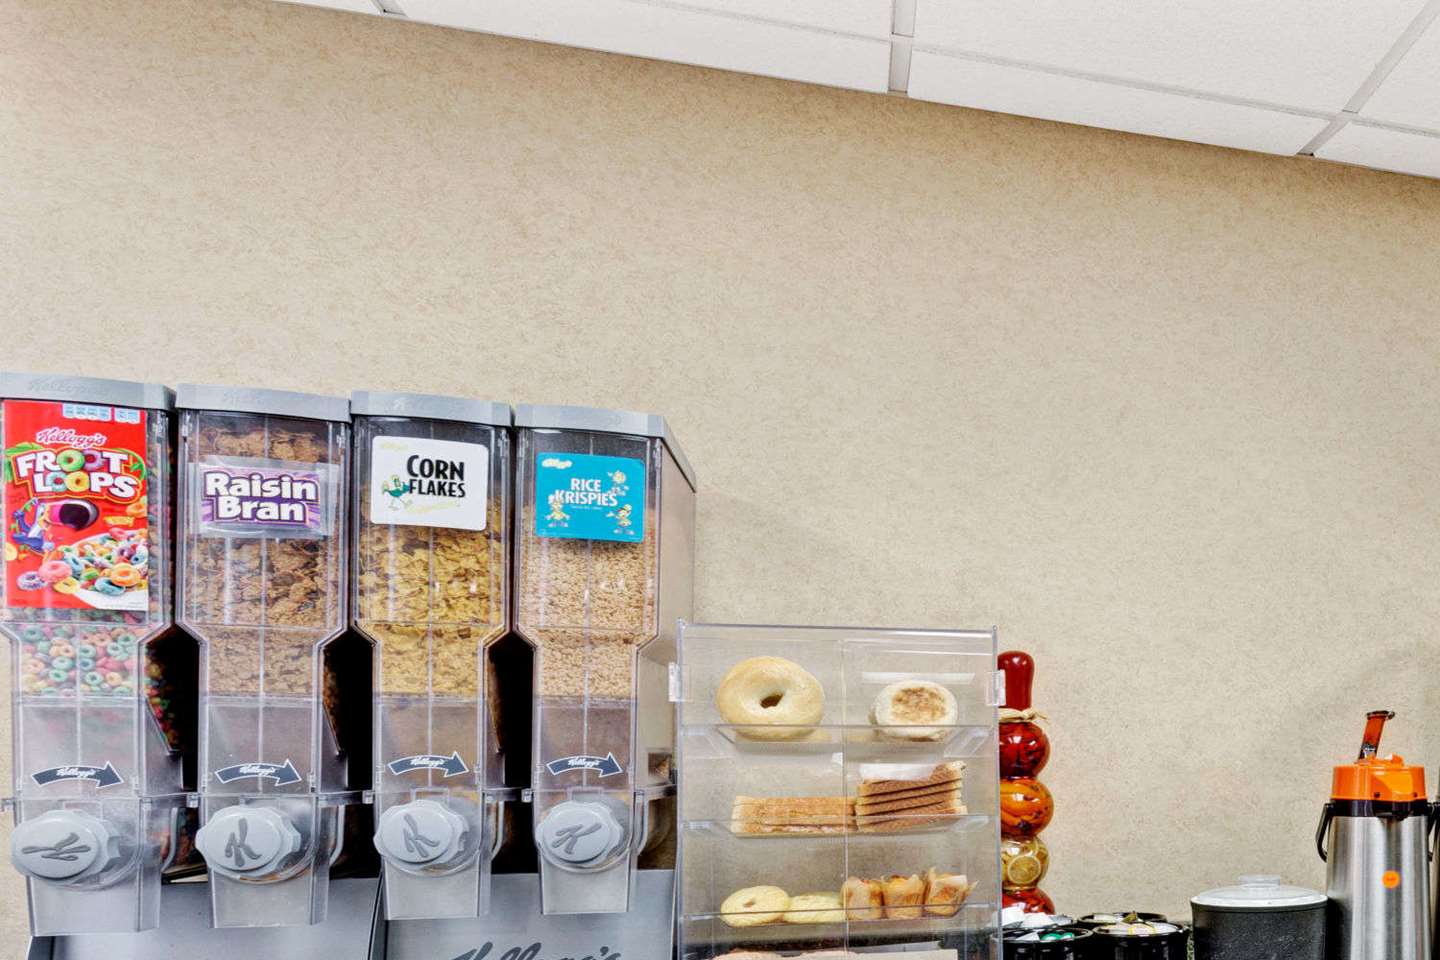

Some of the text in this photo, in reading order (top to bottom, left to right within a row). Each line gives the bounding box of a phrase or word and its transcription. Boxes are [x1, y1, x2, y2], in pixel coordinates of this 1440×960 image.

[38, 428, 105, 447] Kellogg's
[16, 449, 128, 477] FROOT
[407, 454, 465, 481] CORN
[33, 471, 138, 498] LOOPS
[205, 471, 318, 501] Raisin
[409, 478, 466, 498] FLAKES
[570, 477, 602, 492] RICE
[217, 495, 305, 521] Bran
[553, 489, 618, 507] KRISPIES
